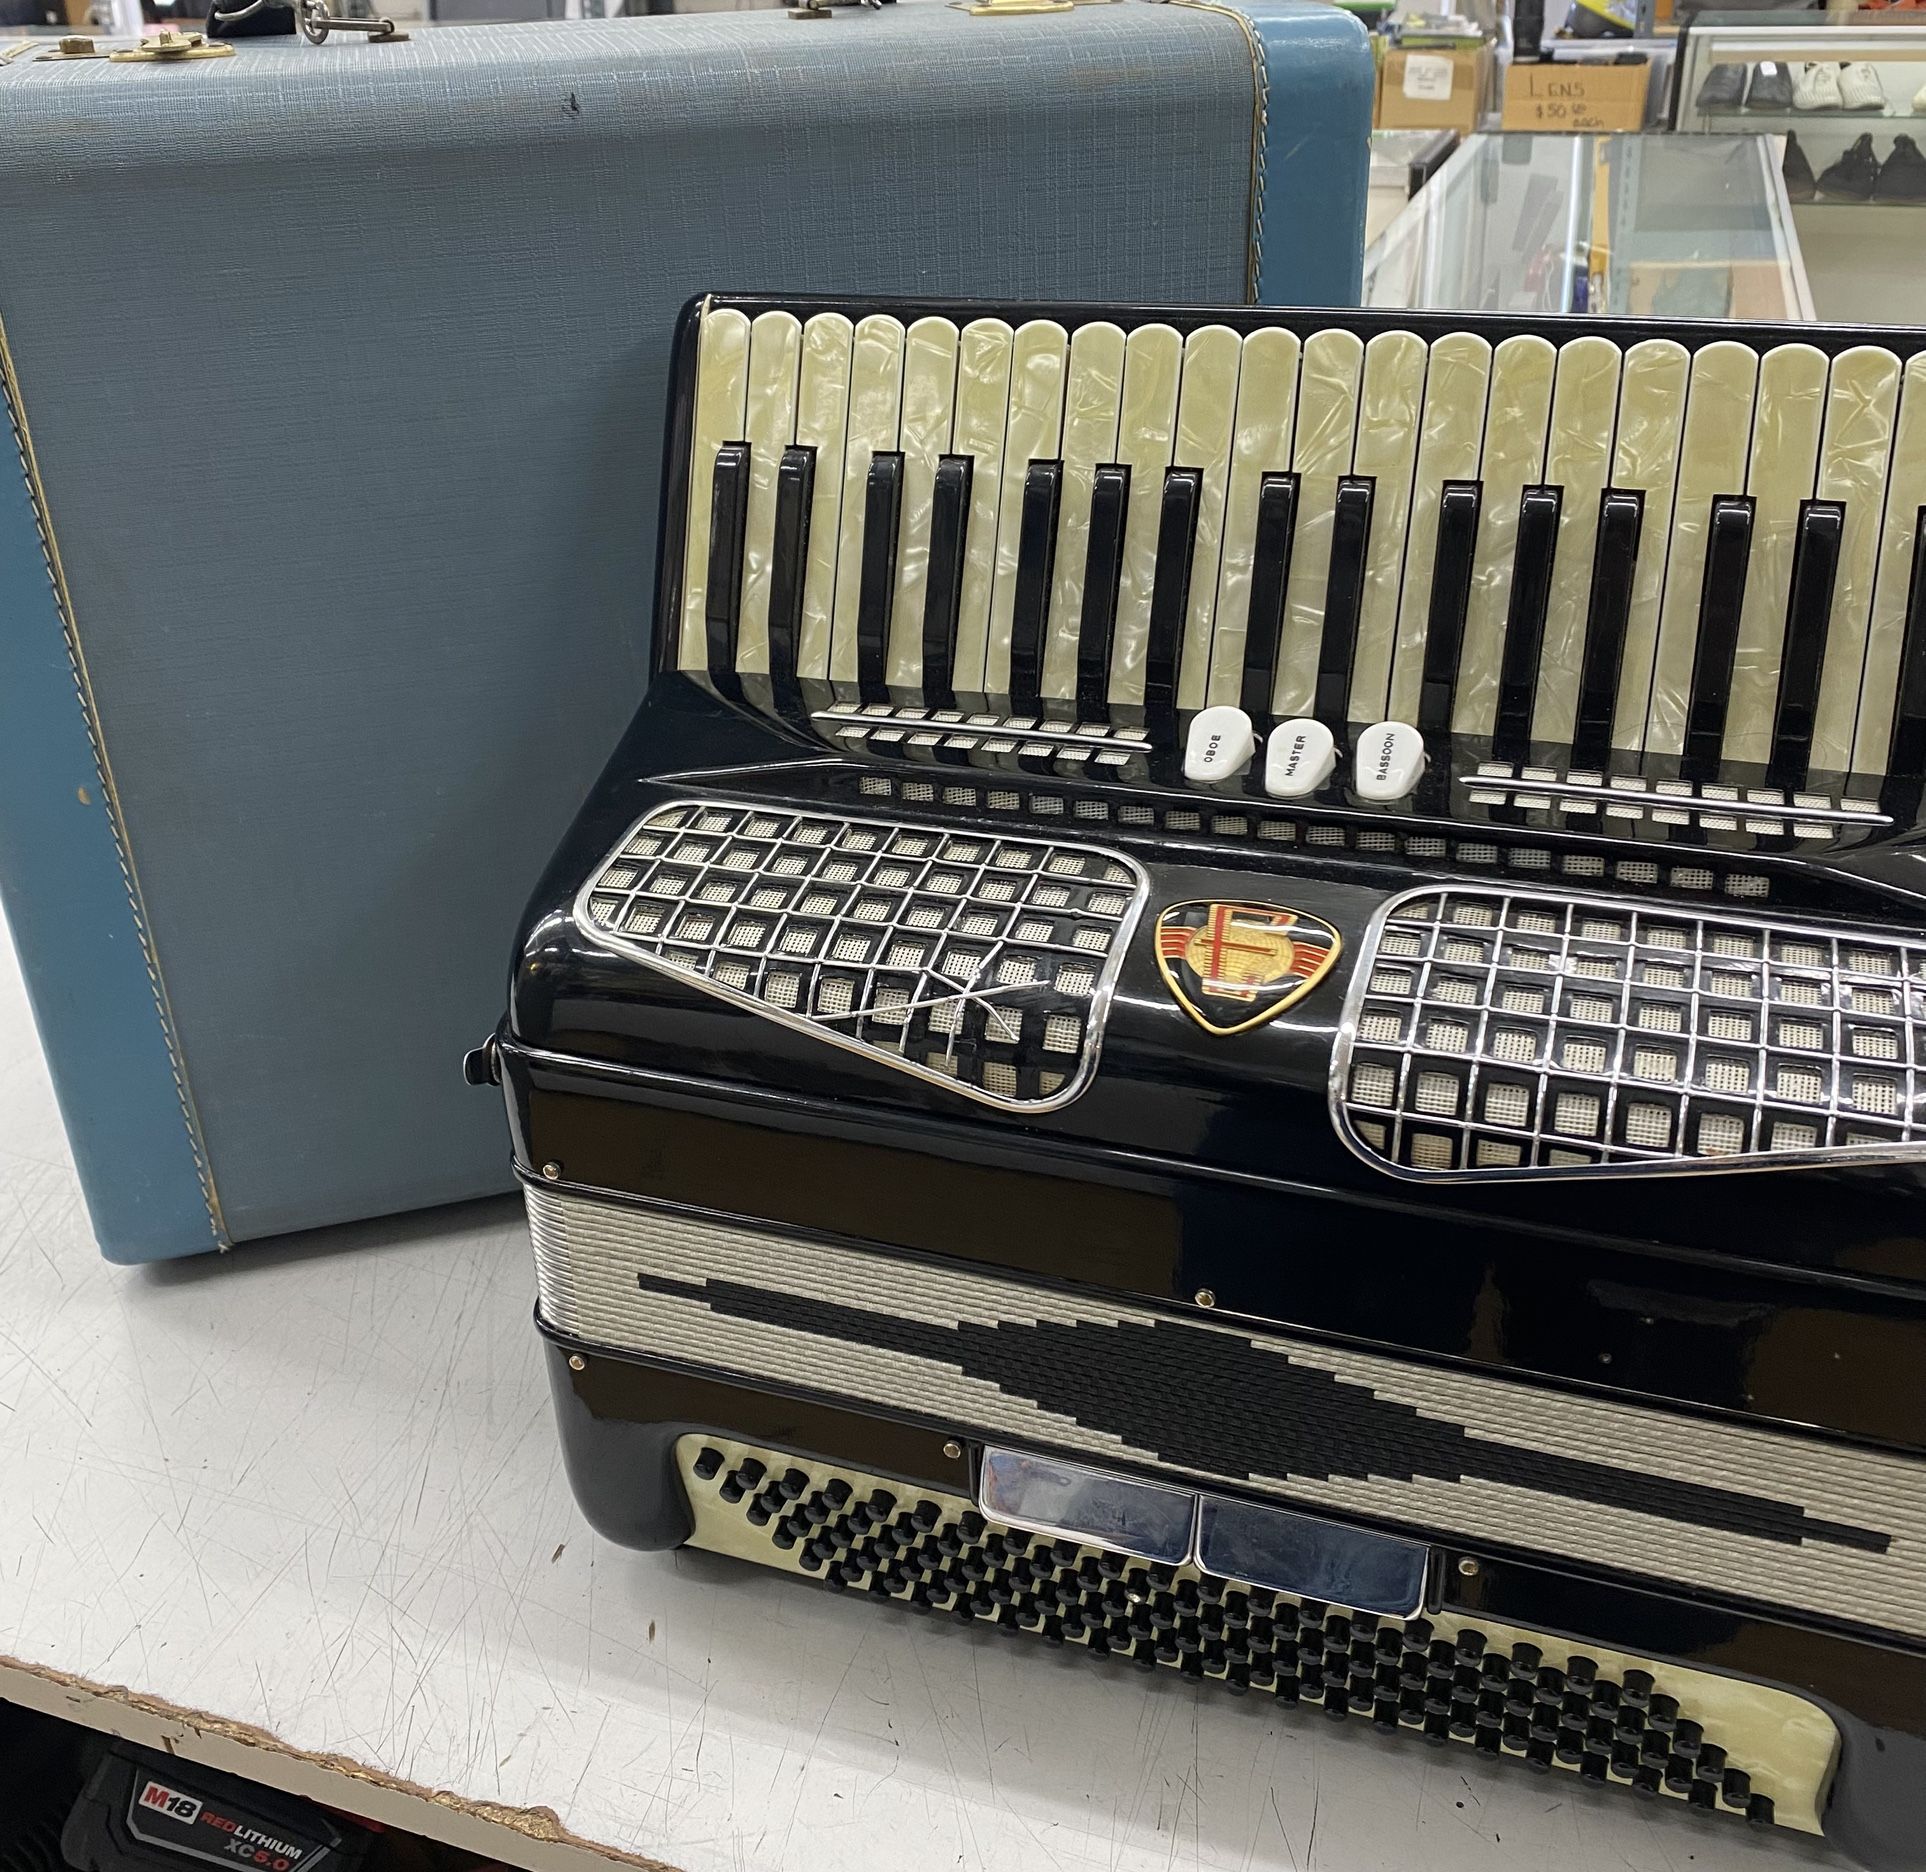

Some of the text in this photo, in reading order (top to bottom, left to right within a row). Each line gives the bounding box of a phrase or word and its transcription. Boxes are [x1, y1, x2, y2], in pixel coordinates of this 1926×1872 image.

[1203, 734, 1222, 764] OBOE
[1284, 735, 1307, 777] MASTER
[1375, 732, 1396, 781] BASSOON
[143, 1786, 197, 1818] M18
[224, 1838, 290, 1871] XC5.0
